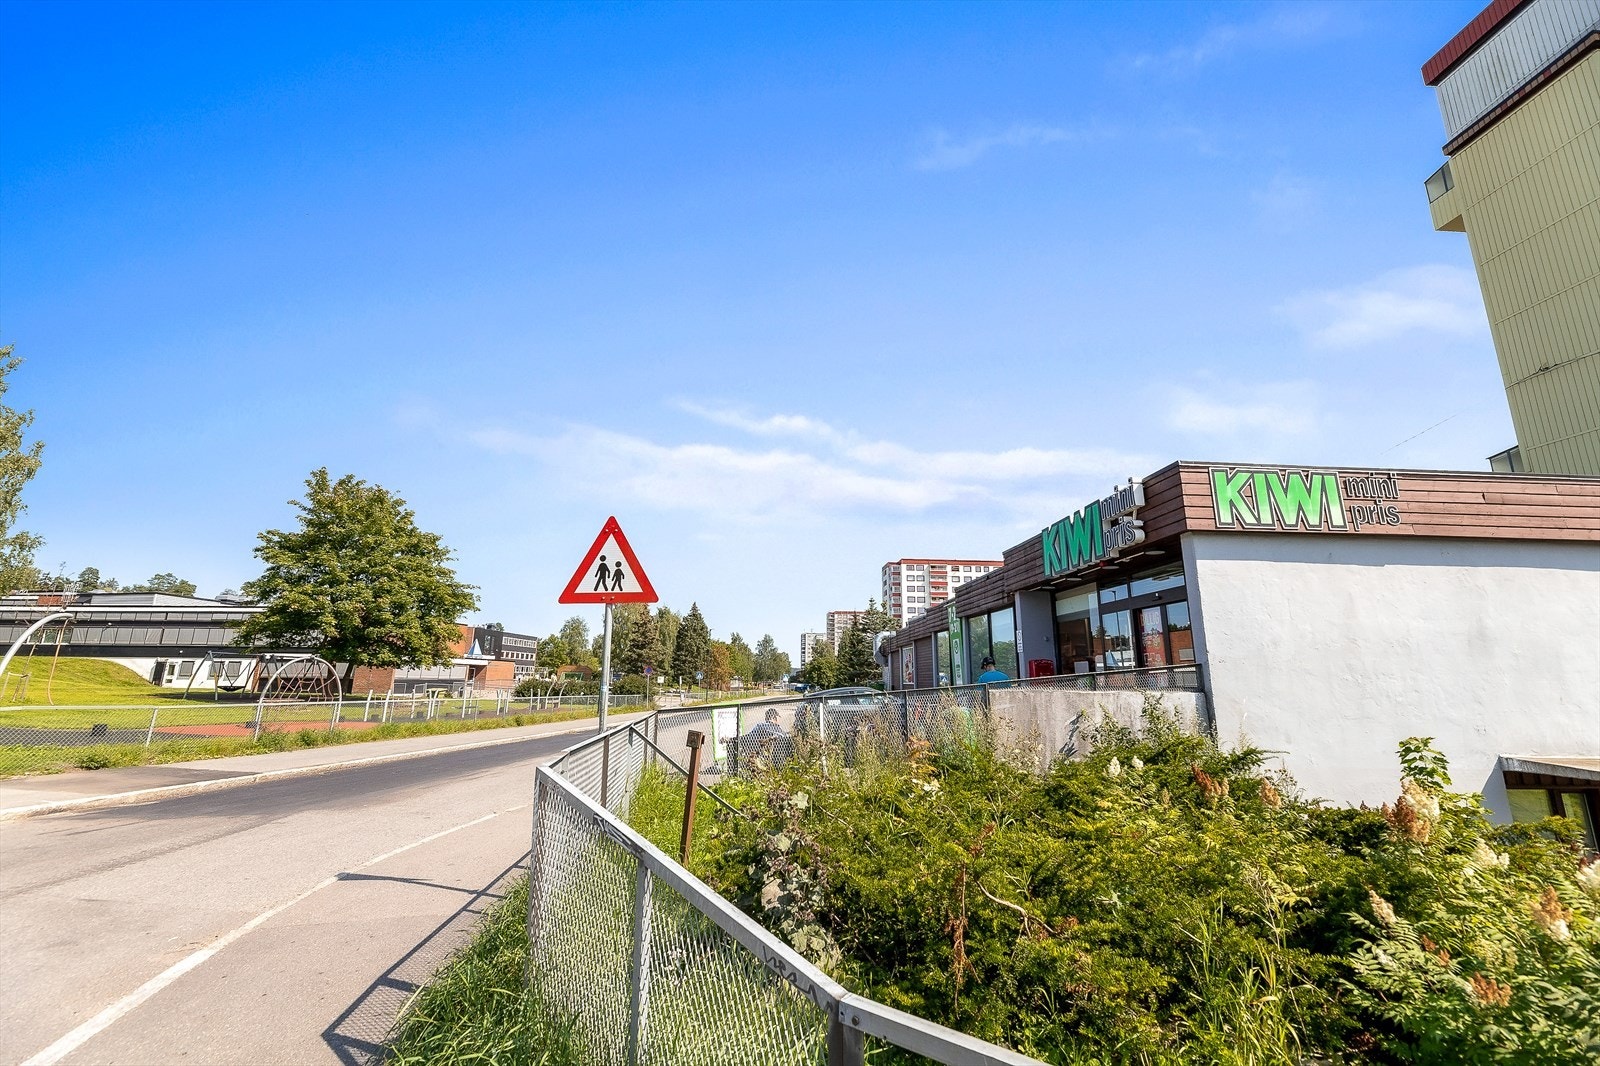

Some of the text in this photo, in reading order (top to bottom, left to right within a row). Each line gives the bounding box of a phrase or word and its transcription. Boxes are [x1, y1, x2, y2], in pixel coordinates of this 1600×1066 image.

[1100, 477, 1136, 520] mini
[1209, 467, 1349, 531] KIWI
[1346, 471, 1401, 500] mini
[1350, 498, 1401, 532] pris
[1042, 499, 1105, 577] KIWI
[1103, 517, 1137, 558] pris
